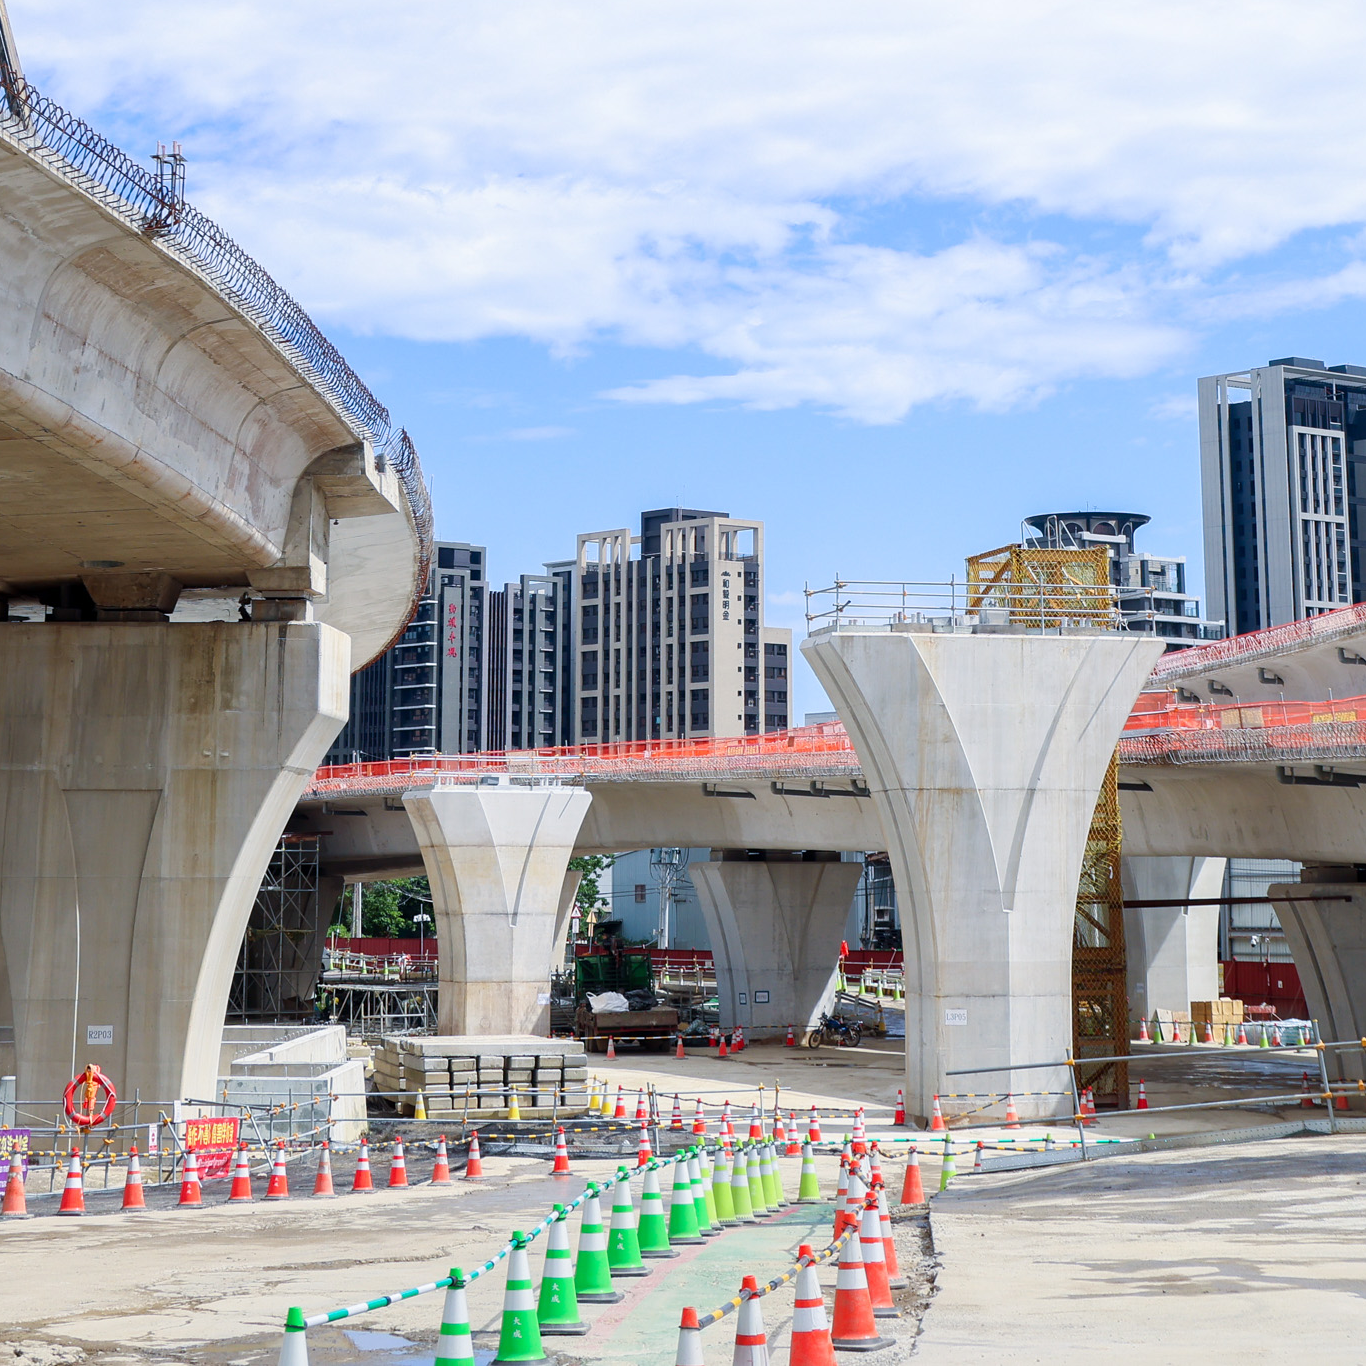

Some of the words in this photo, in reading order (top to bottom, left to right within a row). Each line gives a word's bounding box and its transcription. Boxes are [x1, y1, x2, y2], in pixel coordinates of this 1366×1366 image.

[88, 1030, 112, 1040] R2P03
[616, 1232, 625, 1251] 大成
[550, 1282, 561, 1304] 大成
[513, 1316, 523, 1339] 大成
